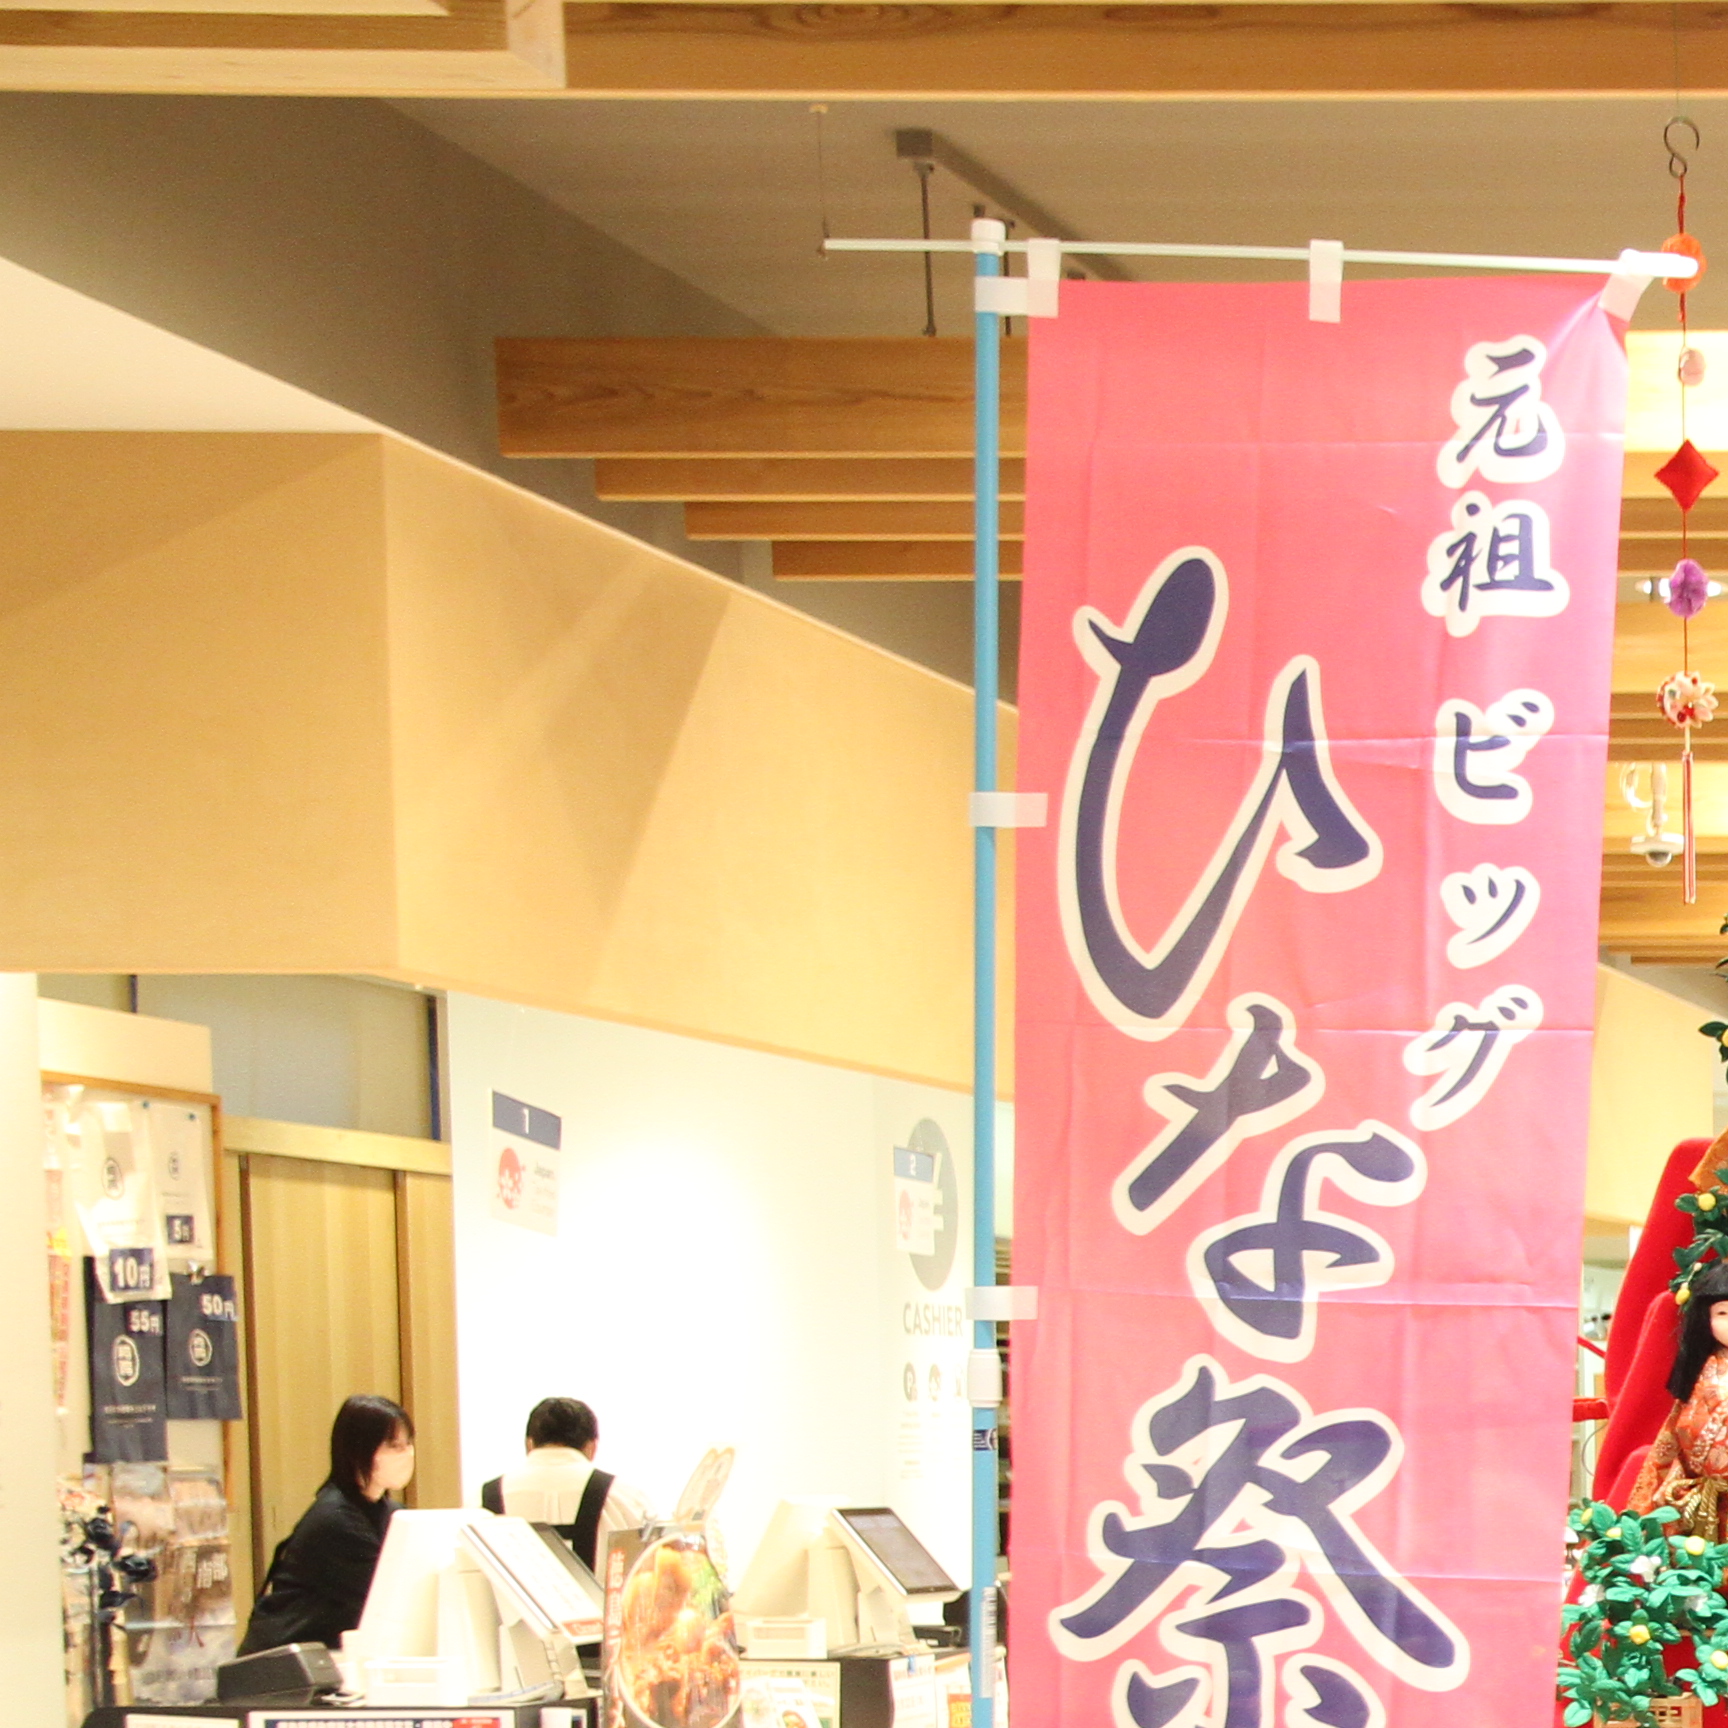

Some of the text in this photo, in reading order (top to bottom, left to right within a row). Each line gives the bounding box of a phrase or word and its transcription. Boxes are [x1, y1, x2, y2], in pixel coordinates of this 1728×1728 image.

[521, 1107, 530, 1135] 1
[908, 1153, 918, 1177] 2
[902, 1300, 965, 1337] CASHIER
